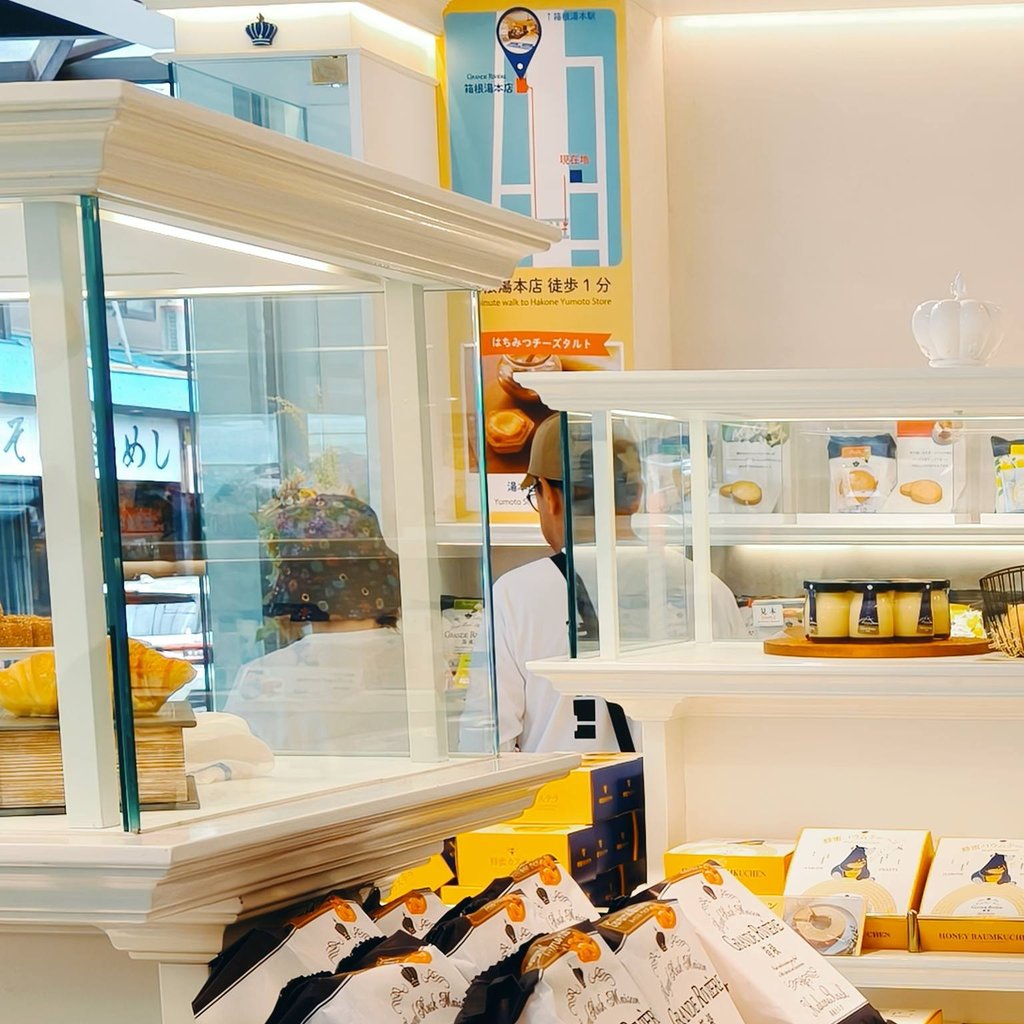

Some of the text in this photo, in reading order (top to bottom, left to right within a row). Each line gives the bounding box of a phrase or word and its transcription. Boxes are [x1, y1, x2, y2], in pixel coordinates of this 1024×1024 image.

[559, 155, 590, 165] 現在地
[502, 298, 519, 307] walk
[530, 298, 559, 306] Hakone
[560, 298, 590, 306] Yumoto
[592, 297, 612, 306] Store
[491, 337, 592, 349] はちみつチーズタルト
[122, 424, 171, 470] めし
